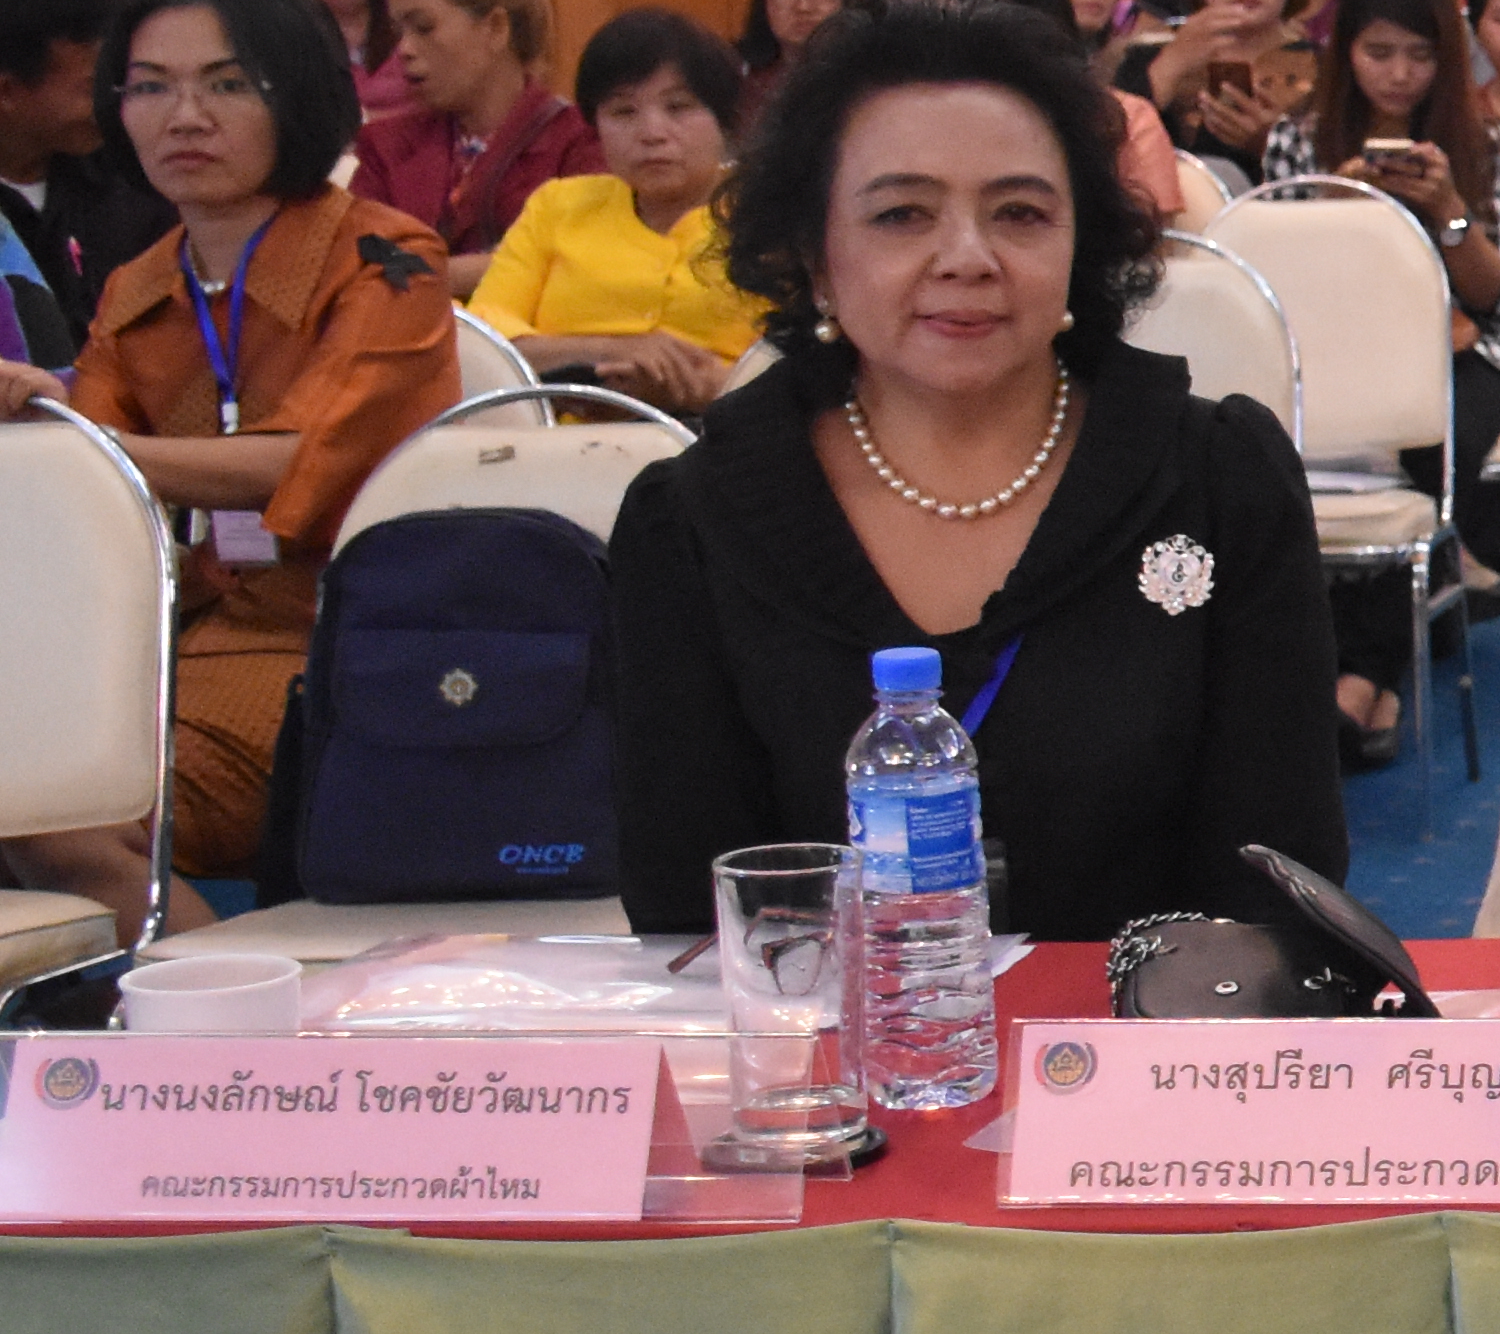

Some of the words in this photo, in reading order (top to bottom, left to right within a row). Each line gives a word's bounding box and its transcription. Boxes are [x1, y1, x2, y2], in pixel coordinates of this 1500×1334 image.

[499, 843, 585, 864] ONCB
[101, 1069, 343, 1114] นางนงลักษณ์
[355, 1070, 632, 1115] โชคชัยวัฒนากร
[1150, 1048, 1354, 1104] นางสุปรียา
[140, 1165, 541, 1201] คณะกรรมการประกวดผ้าไหม
